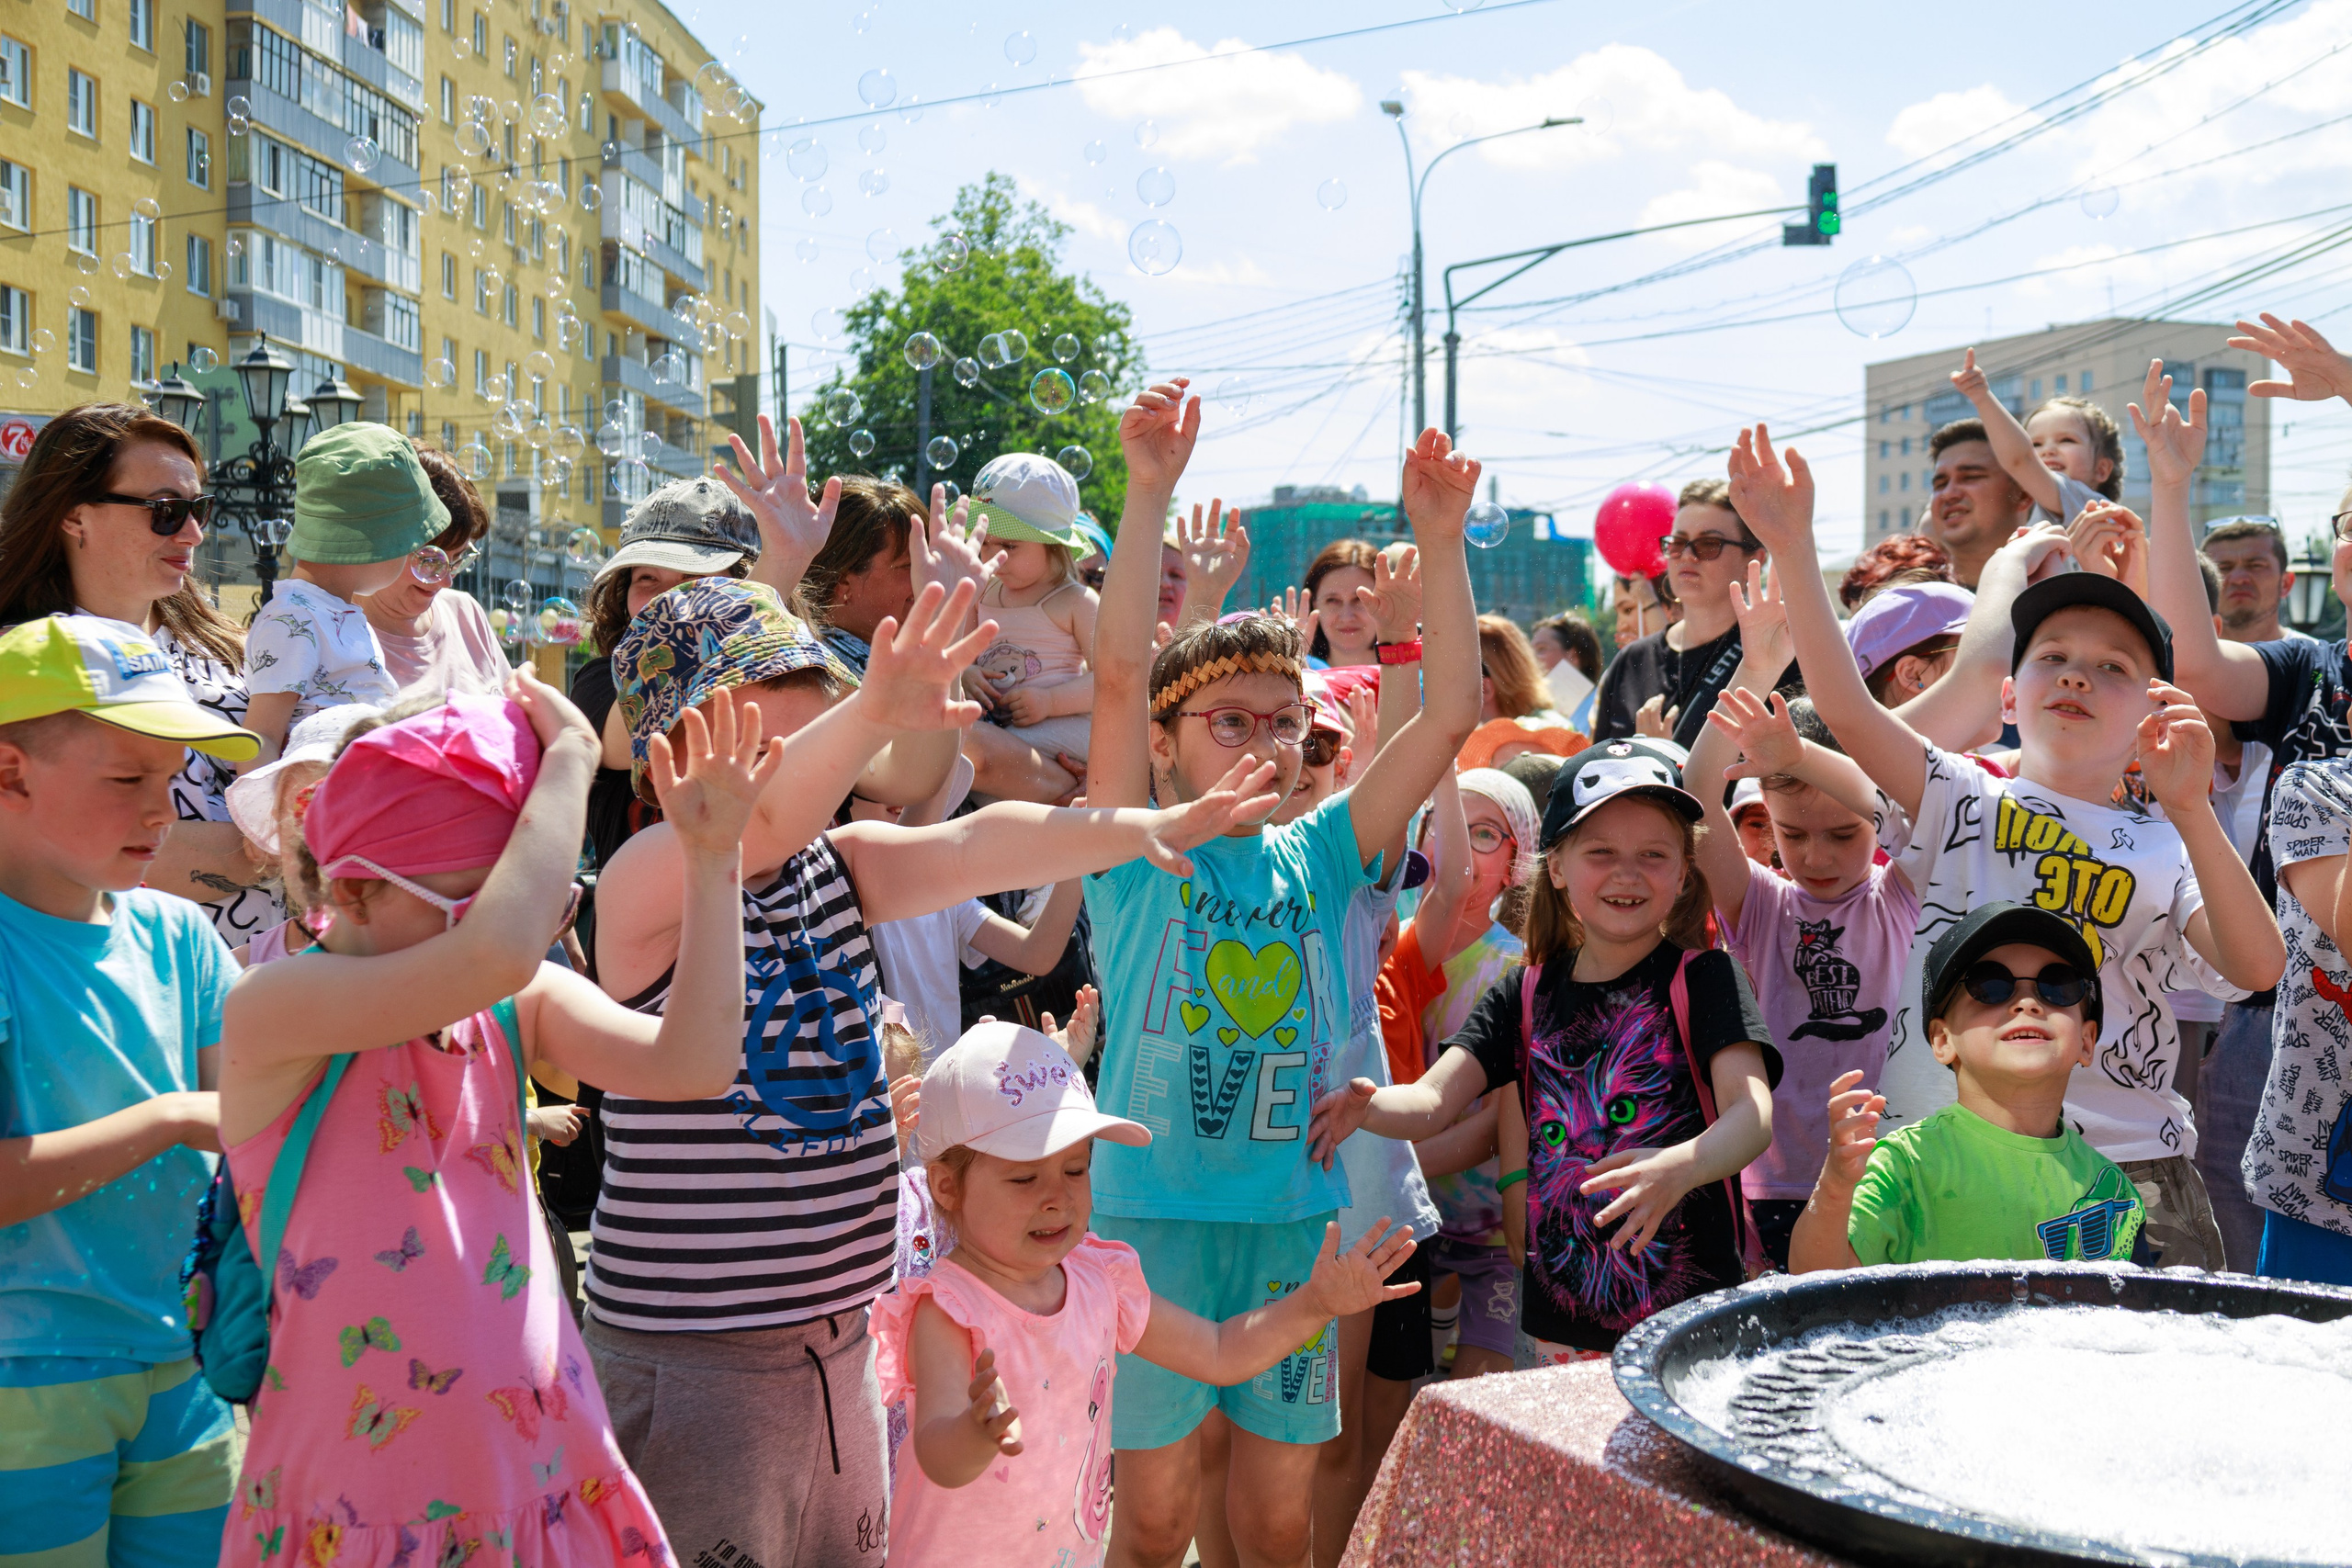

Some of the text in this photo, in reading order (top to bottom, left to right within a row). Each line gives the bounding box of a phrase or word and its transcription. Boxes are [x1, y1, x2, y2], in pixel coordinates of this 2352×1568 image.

[2292, 845, 2320, 858] MAN
[2032, 852, 2136, 929] ЭТО
[1217, 955, 1295, 999] and
[1806, 964, 1851, 987] BEST
[1813, 989, 1853, 1016] FRIEND
[2313, 1058, 2331, 1081] MAN
[2278, 1150, 2320, 1168] SPIDER-
[2285, 1165, 2308, 1178] MAN
